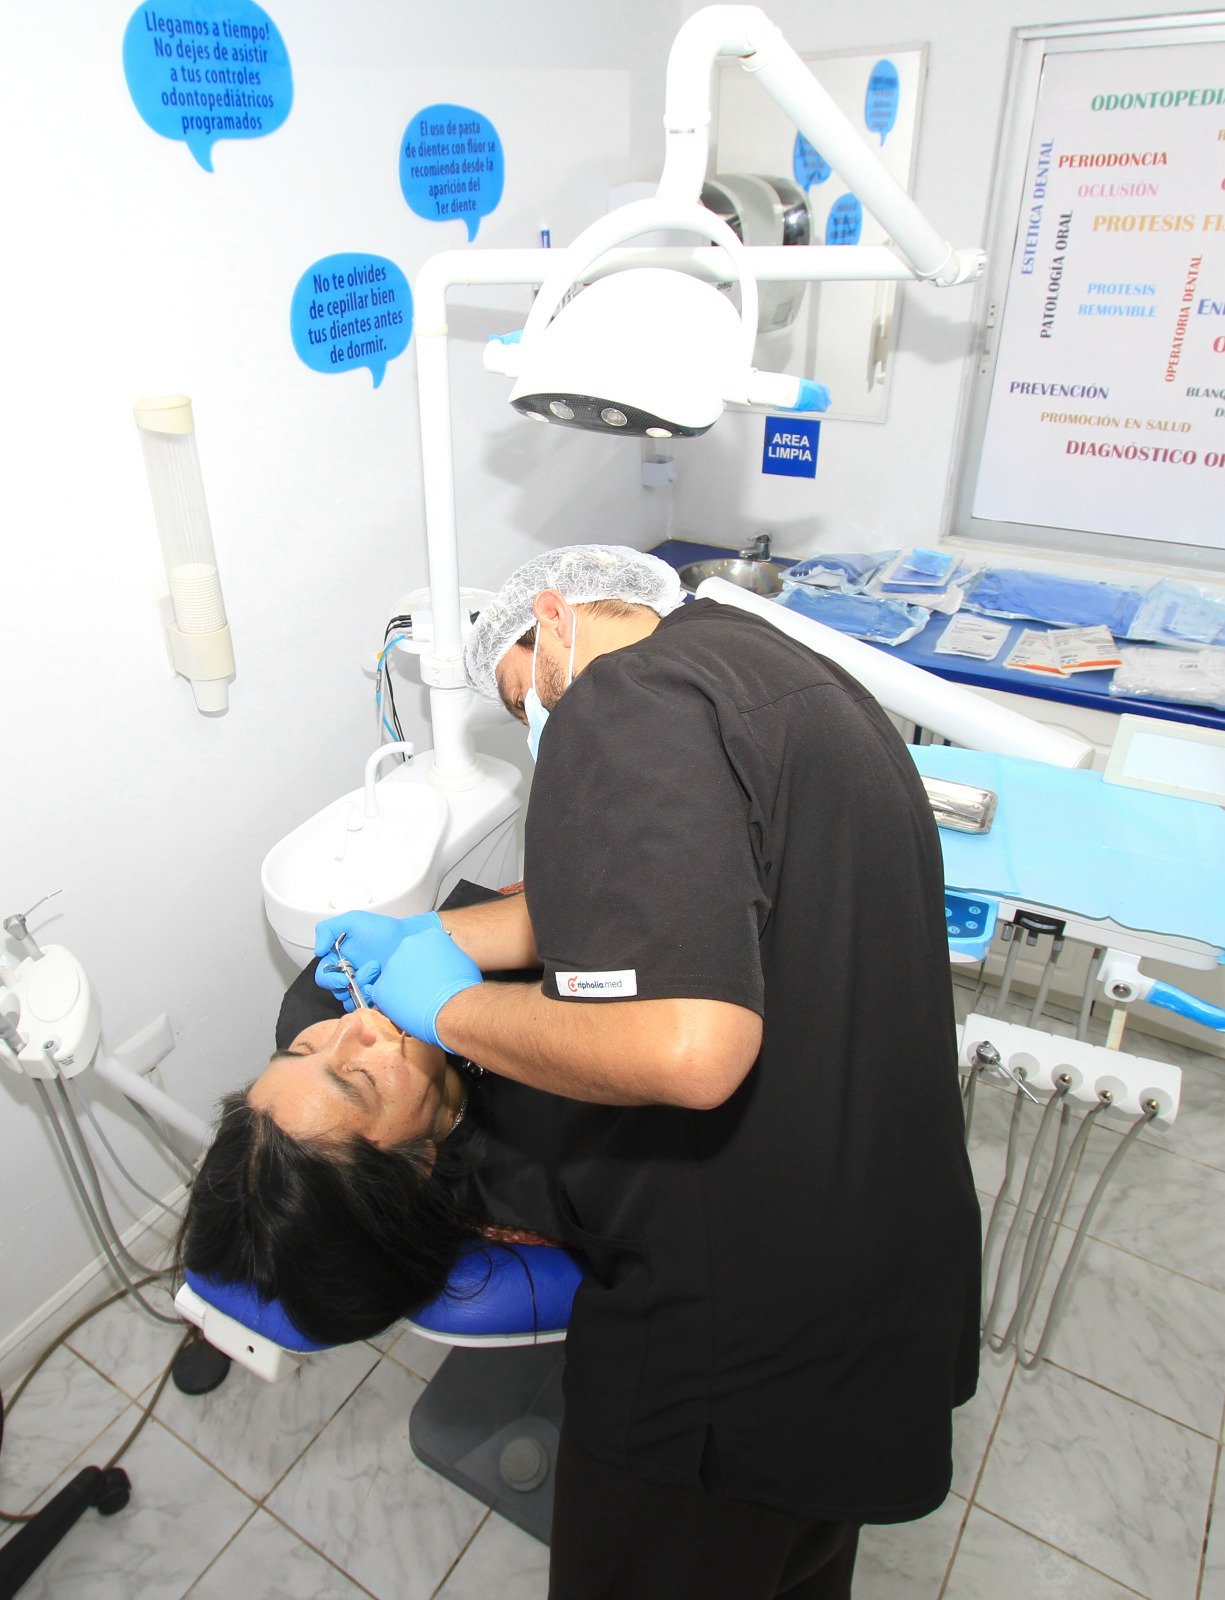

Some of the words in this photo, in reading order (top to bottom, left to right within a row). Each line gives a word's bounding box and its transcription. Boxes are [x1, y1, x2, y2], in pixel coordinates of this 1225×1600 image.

[145, 11, 209, 38] Llegamos
[212, 22, 220, 36] a
[222, 19, 270, 44] tiempo!
[154, 37, 173, 58] No
[176, 38, 210, 64] dejes
[214, 41, 228, 61] de
[232, 44, 268, 63] asistir
[170, 67, 178, 82] a
[181, 66, 201, 83] tus
[205, 66, 261, 85] controles
[161, 86, 274, 111] odontopediátricos
[181, 112, 262, 135] programados
[420, 120, 428, 137] El
[430, 123, 444, 136] uso
[447, 120, 457, 135] de
[458, 121, 480, 138] pasta
[405, 142, 416, 158] de
[418, 141, 450, 157] dientes
[452, 143, 465, 155] con
[467, 138, 485, 153] flúor
[488, 141, 496, 152] se
[411, 160, 460, 178] recomienda
[462, 158, 484, 174] desde
[486, 157, 493, 171] la
[1033, 137, 1055, 199] DENTAL
[1058, 151, 1168, 168] PERIODONCIA
[428, 178, 466, 200] aparición
[468, 177, 480, 192] del
[1077, 180, 1159, 198] OCLUSIÓN
[436, 201, 449, 215] 1er
[451, 198, 477, 213] diente
[1092, 214, 1196, 232] PROTESIS
[1202, 213, 1225, 232] FI
[313, 274, 330, 294] No
[332, 273, 345, 290] te
[347, 264, 387, 287] olvides
[1040, 256, 1066, 339] PATOLOGÍA
[1055, 209, 1074, 251] ORAL
[1087, 283, 1157, 296] PROTESIS
[309, 300, 324, 320] de
[327, 291, 369, 319] cepillar
[371, 287, 395, 307] bien
[1078, 303, 1158, 317] REMOVIBLE
[1197, 298, 1225, 315] EN
[308, 328, 327, 345] tus
[330, 317, 372, 340] dientes
[374, 310, 403, 330] antes
[1164, 306, 1191, 383] OPERATORIA
[1182, 255, 1203, 302] DENTAL
[330, 345, 344, 364] de
[346, 334, 387, 359] dormir.
[1009, 380, 1110, 400] PREVENCIÓN
[1040, 411, 1120, 428] PROMOCIÓN
[1124, 417, 1142, 429] EN
[1146, 419, 1192, 433] SALUD
[772, 432, 810, 447] AREA
[768, 446, 813, 462] LIMPIA
[1065, 440, 1197, 465] DIAGNÓSTICO
[604, 979, 623, 988] med
